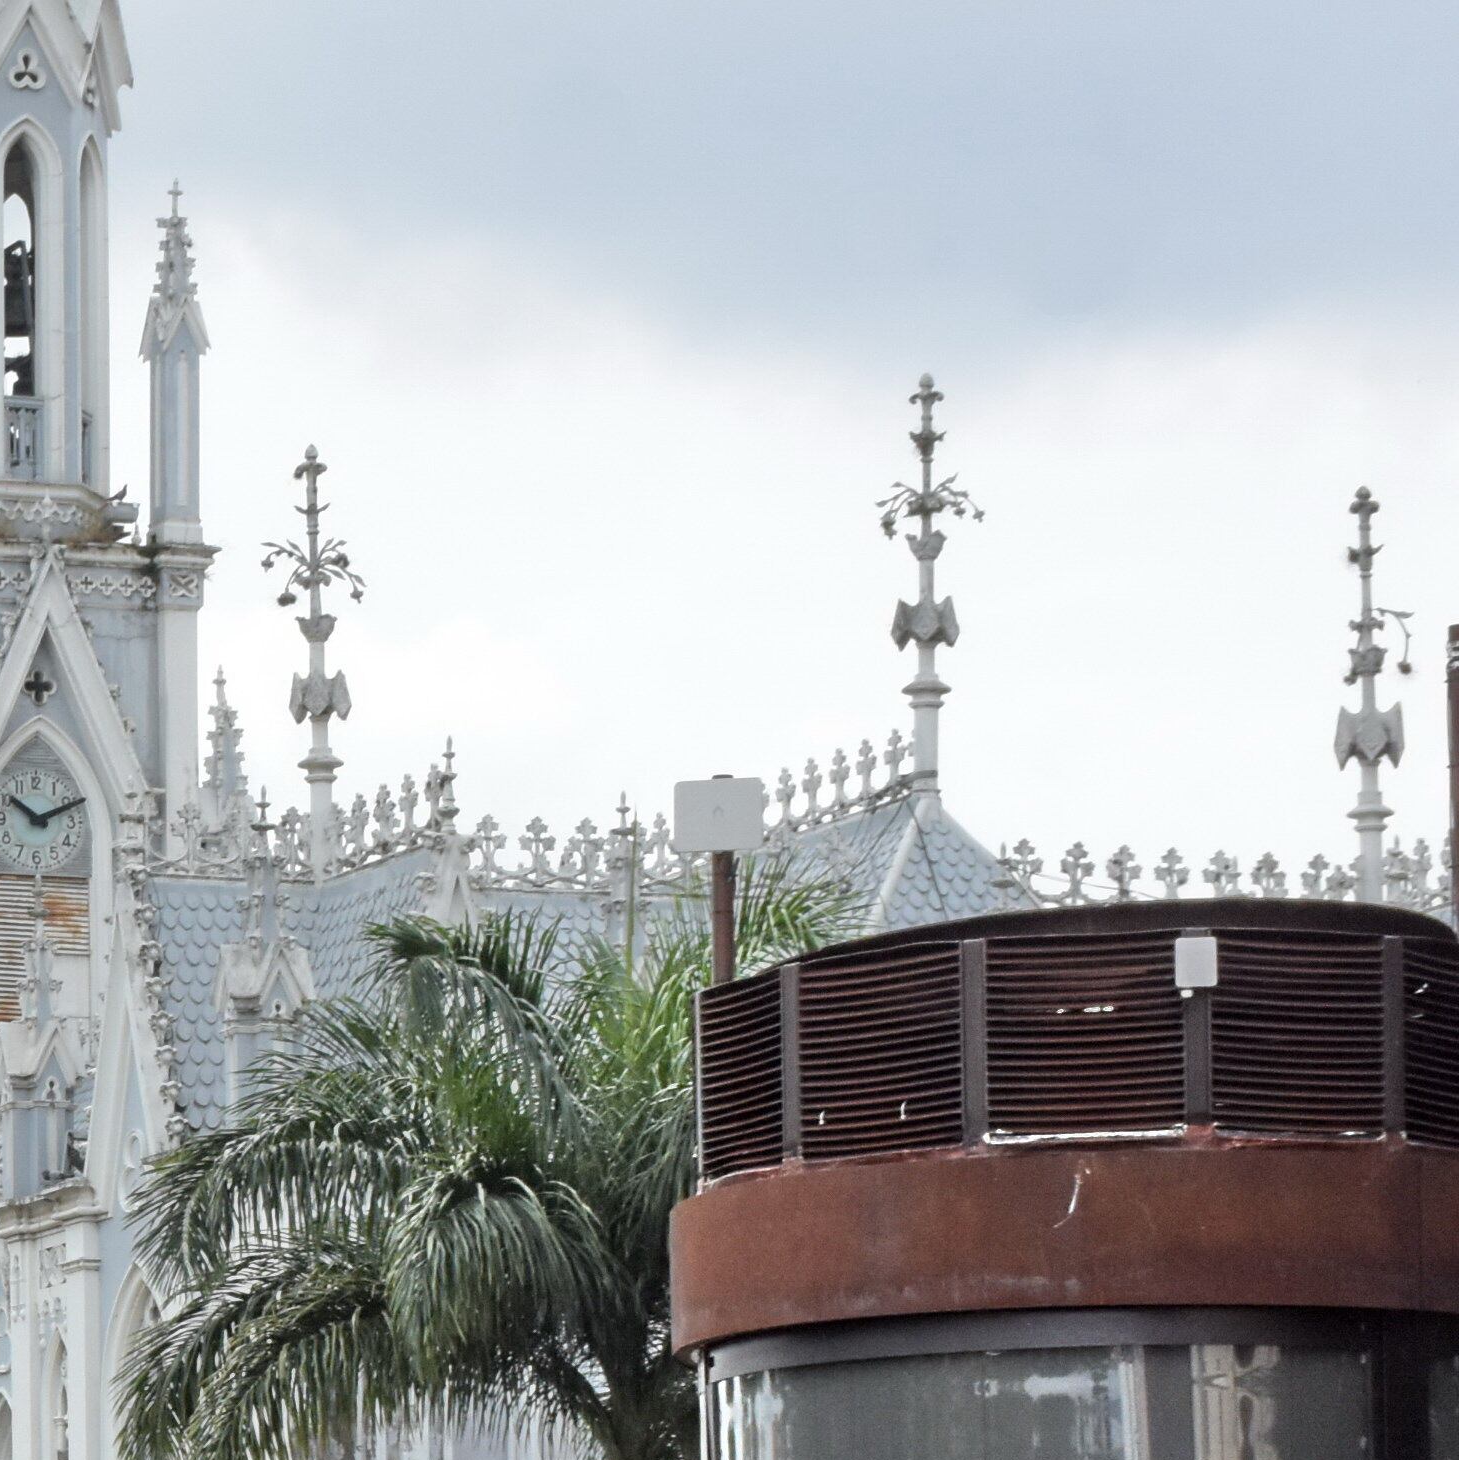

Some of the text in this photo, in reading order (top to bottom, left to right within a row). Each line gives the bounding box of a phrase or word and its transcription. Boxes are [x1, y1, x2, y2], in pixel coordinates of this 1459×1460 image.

[15, 780, 24, 794] 11
[31, 776, 41, 790] 12
[51, 781, 56, 796] 1
[66, 815, 76, 829] 3
[2, 831, 11, 844] 8
[62, 833, 72, 847] 4
[15, 844, 24, 858] 7
[32, 850, 42, 865] 6
[49, 846, 59, 860] 5
